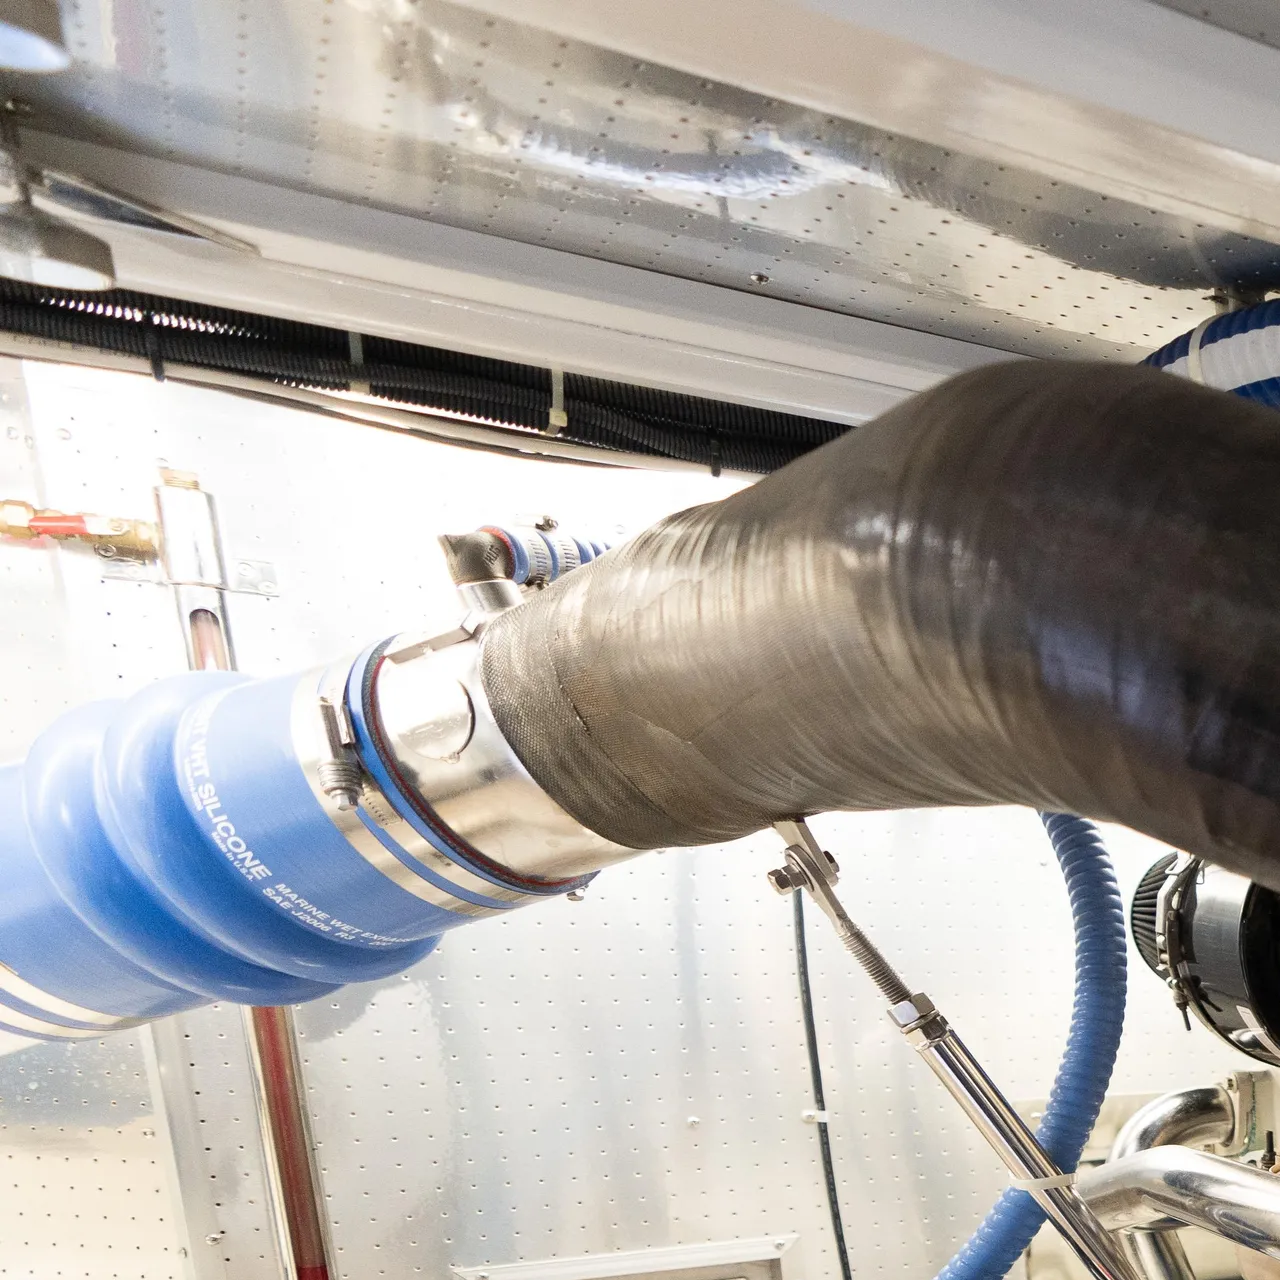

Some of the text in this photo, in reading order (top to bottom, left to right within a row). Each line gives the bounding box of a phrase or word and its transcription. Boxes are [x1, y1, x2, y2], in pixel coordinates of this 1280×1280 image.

[195, 781, 273, 882] SILICONE
[261, 887, 294, 911] SAE
[290, 907, 332, 933] J2006
[274, 882, 330, 922] MARINE
[329, 918, 363, 934] WET
